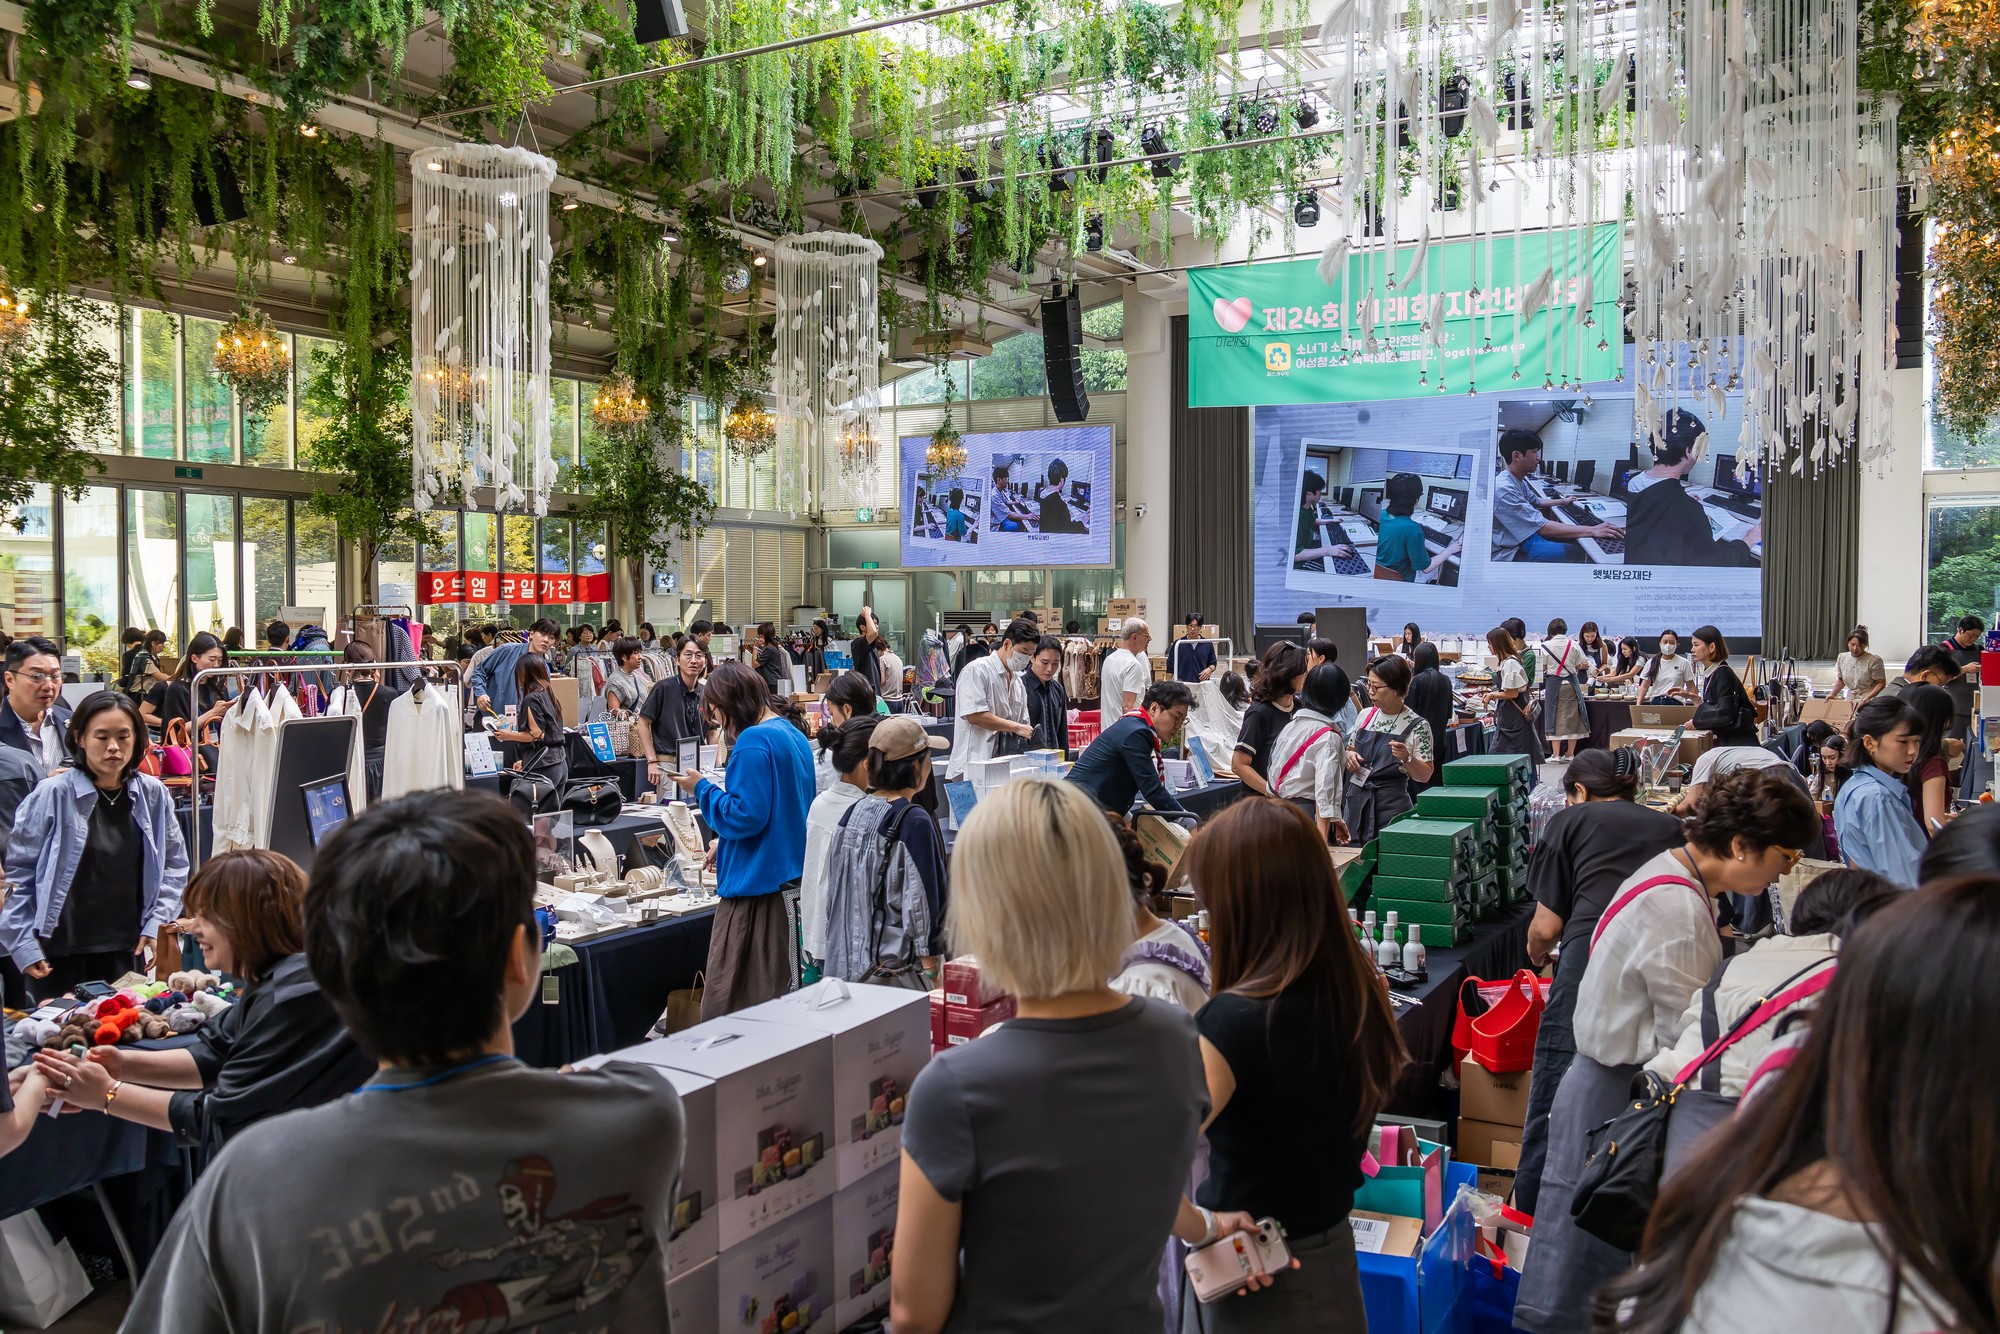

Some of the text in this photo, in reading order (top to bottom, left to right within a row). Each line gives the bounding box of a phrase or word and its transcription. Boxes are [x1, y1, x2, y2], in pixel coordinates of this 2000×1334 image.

[1262, 301, 1347, 331] 제24회
[1215, 335, 1251, 348] 미래회
[1295, 341, 1329, 356] 소녀가
[1592, 569, 1654, 581] 햇빛담요재단
[431, 577, 572, 600] 오브엠 균일가전
